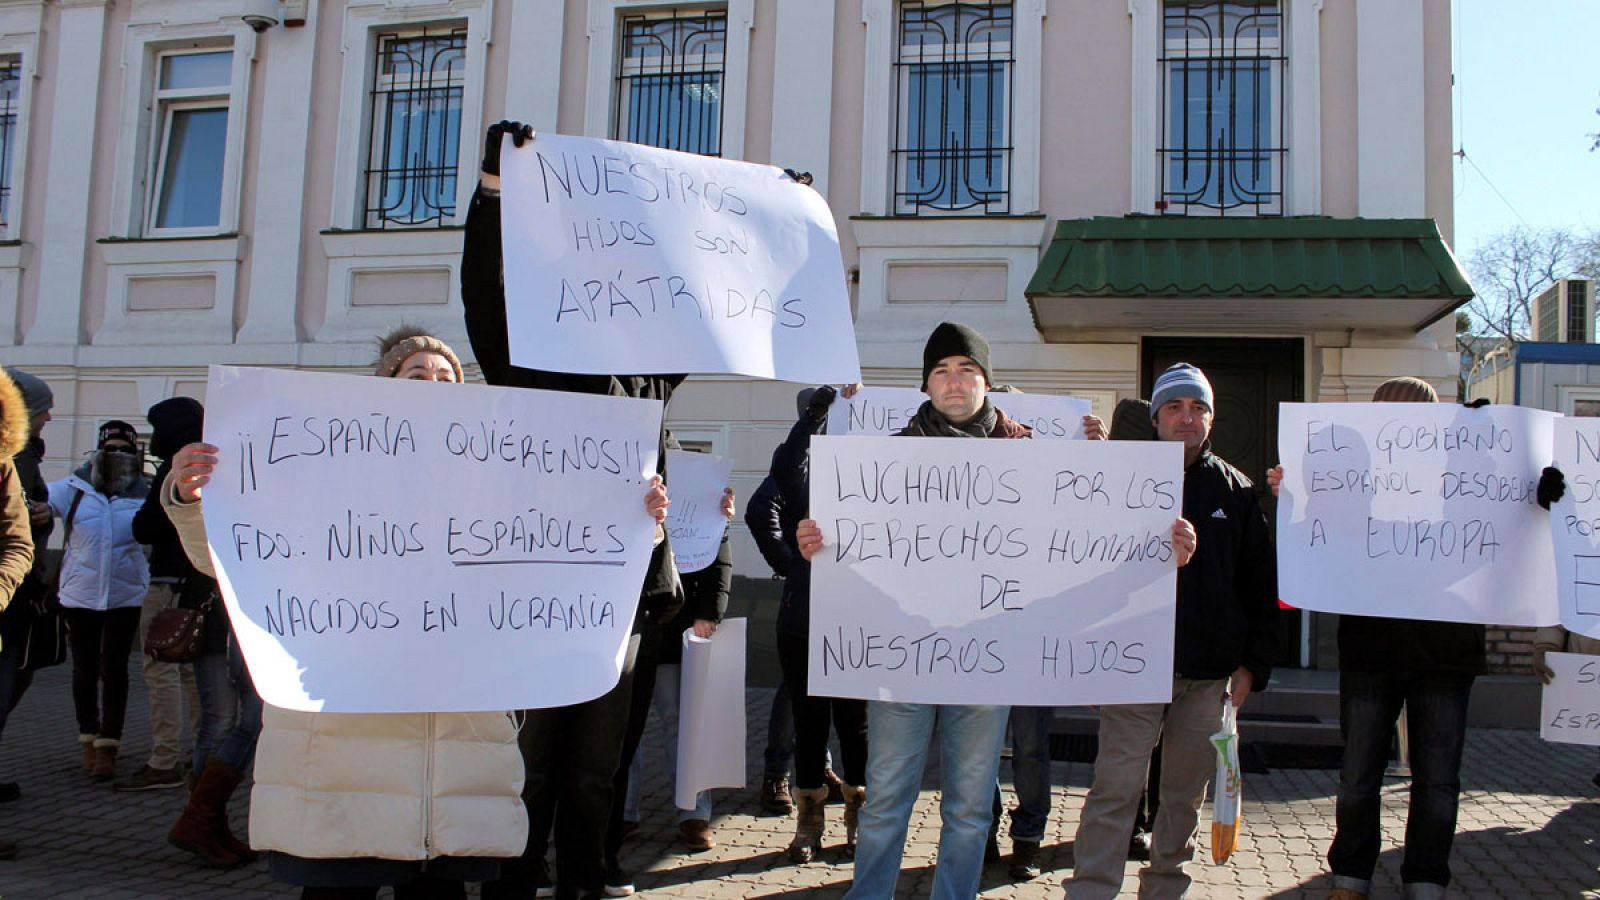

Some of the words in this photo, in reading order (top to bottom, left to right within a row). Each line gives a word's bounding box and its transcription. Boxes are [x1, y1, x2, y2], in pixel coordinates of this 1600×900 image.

[536, 148, 749, 216] NUESTROS
[695, 231, 747, 255] SON
[556, 269, 806, 328] APÁTRIDAS
[1308, 421, 1349, 452] EL
[1376, 420, 1512, 464] GOBIERNO
[835, 456, 1021, 509] LUCHAMOS
[1053, 470, 1110, 506] POR
[1126, 472, 1176, 511] LOS
[1311, 468, 1422, 496] ESPAÑOL
[1441, 472, 1536, 504] DESOBEDE
[328, 509, 424, 561] NIÑOS
[448, 508, 624, 556] ESPAÑOLES
[835, 518, 1029, 567] DERECHOS
[1310, 519, 1326, 547] A
[1367, 516, 1500, 564] EUROPA
[265, 588, 399, 638] NACIDOS
[423, 592, 457, 632] EN
[489, 591, 614, 632] UCRANIA
[980, 574, 1024, 611] DE
[823, 626, 1005, 676] NUESTROS
[1041, 636, 1146, 679] HIJOS
